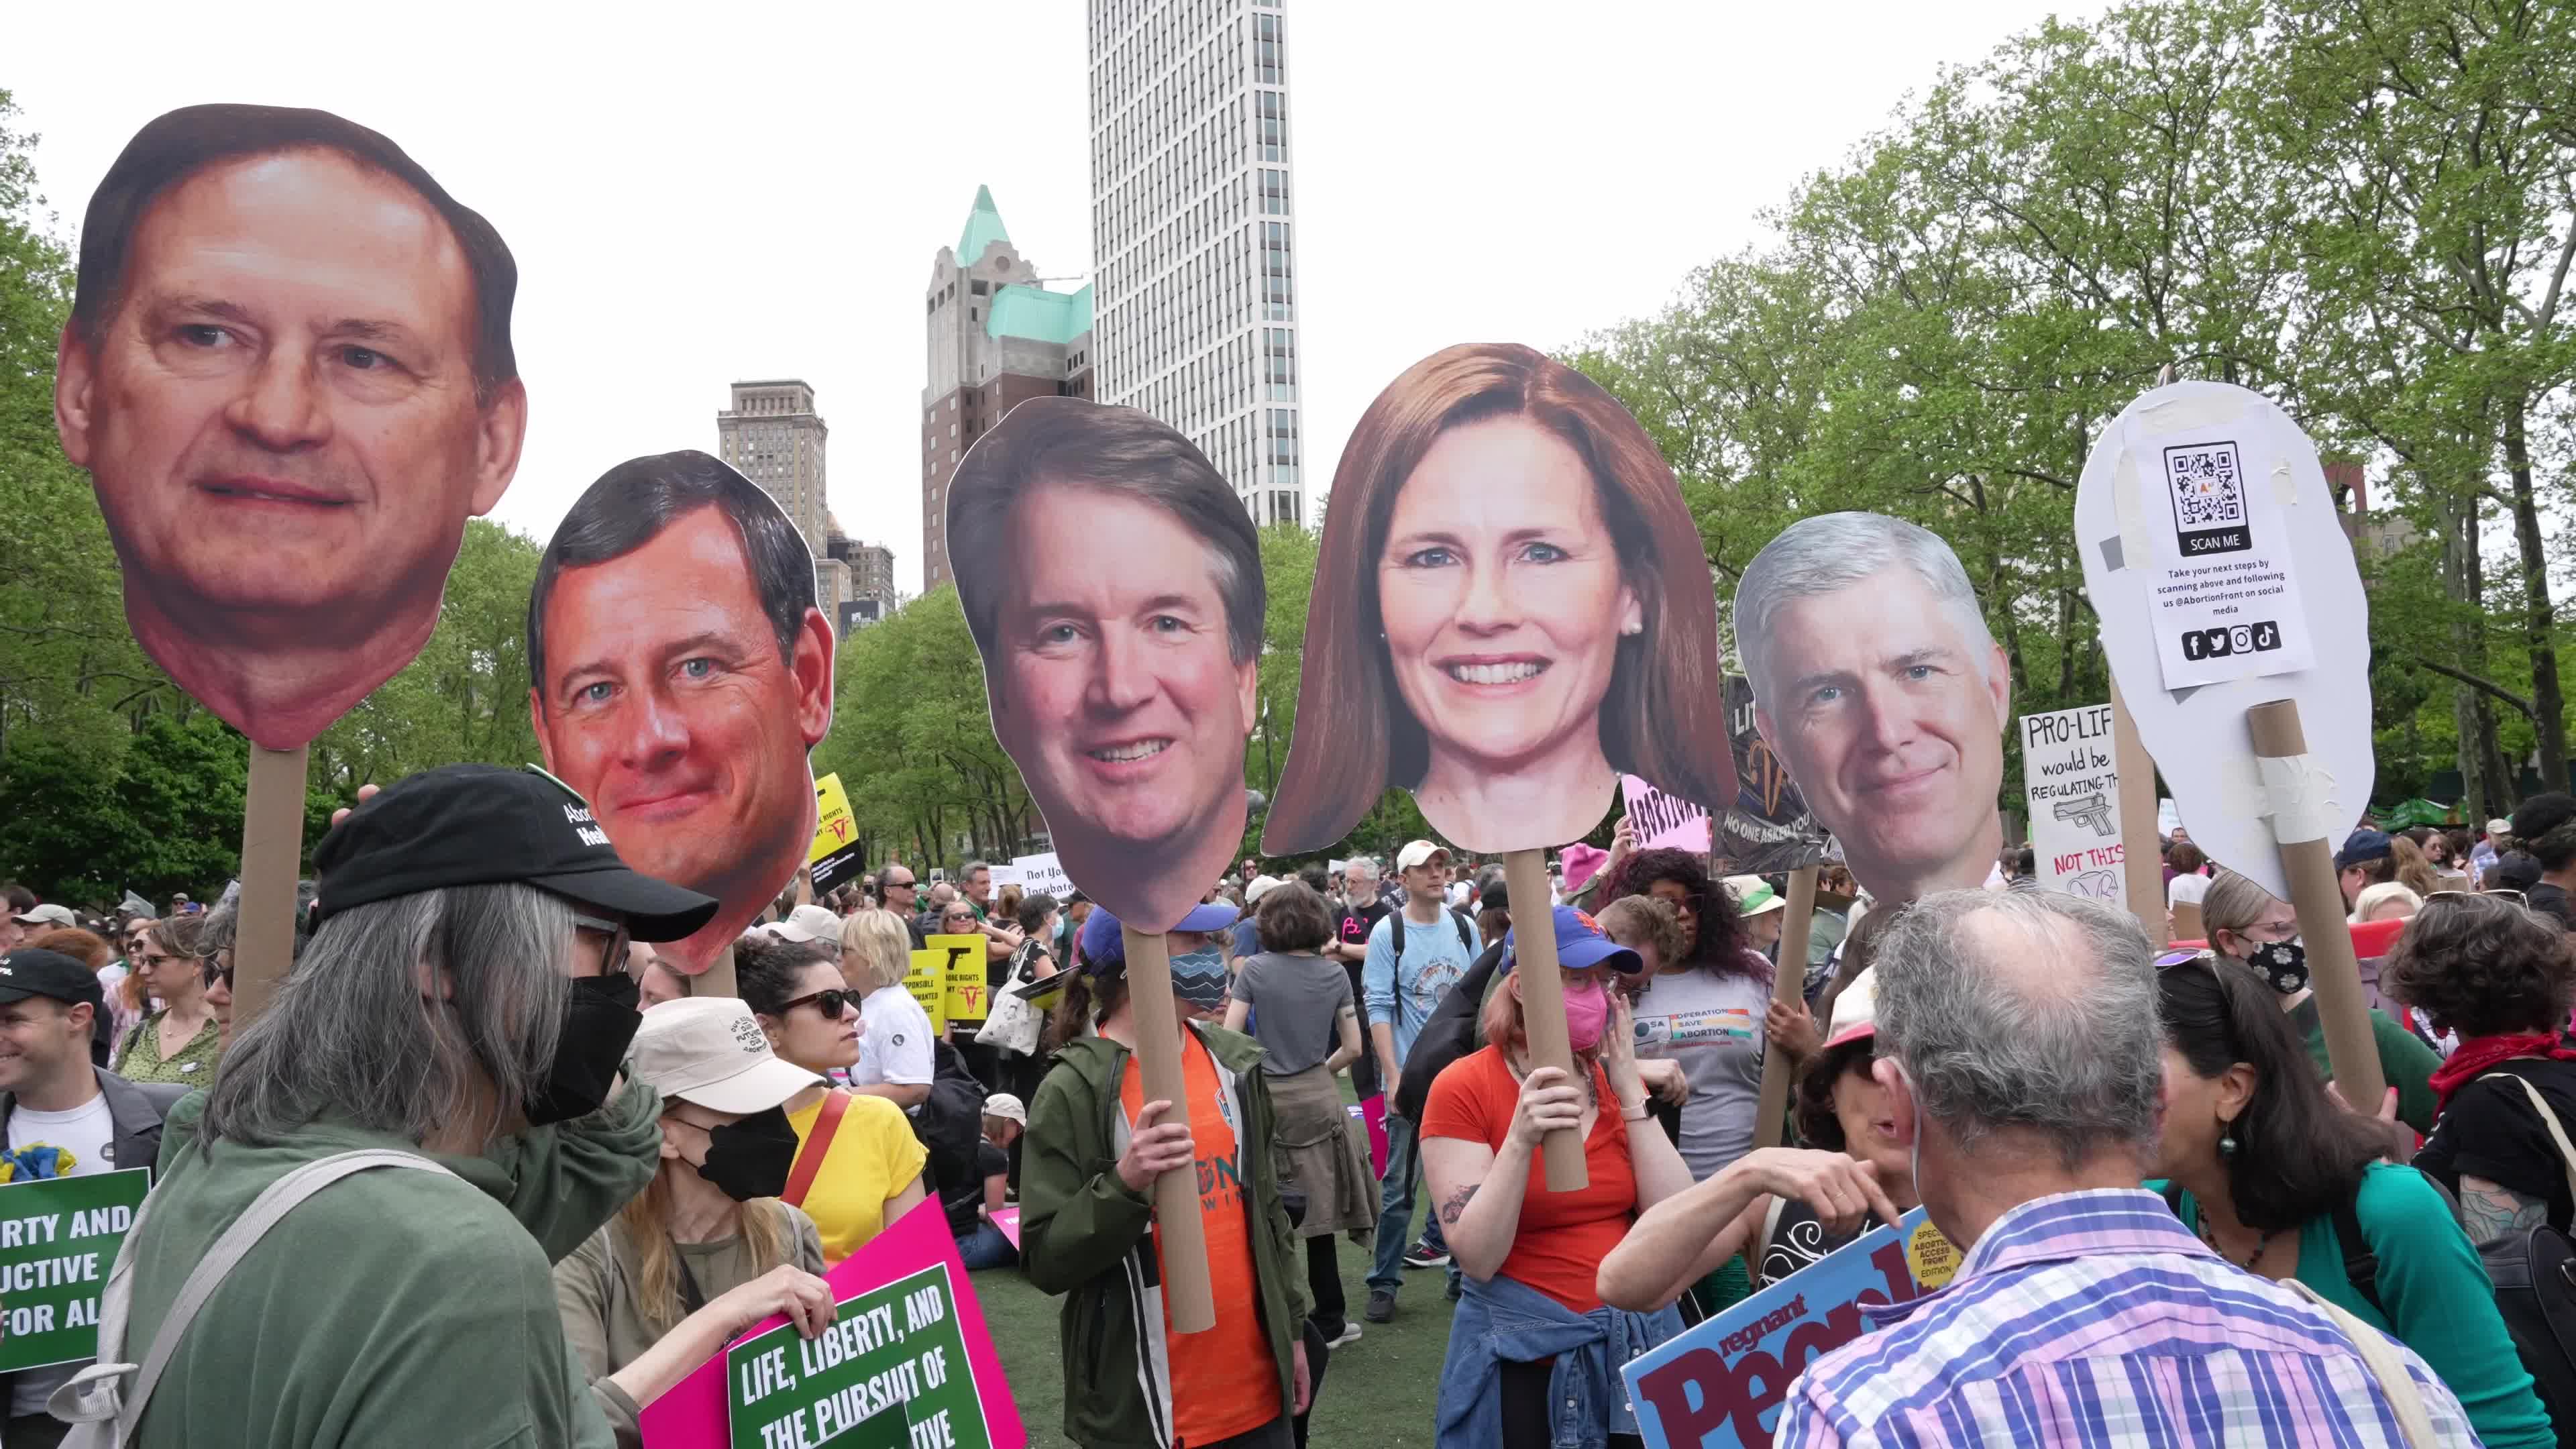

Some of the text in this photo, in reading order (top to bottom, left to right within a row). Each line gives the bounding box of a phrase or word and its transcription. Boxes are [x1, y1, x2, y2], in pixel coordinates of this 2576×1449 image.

[2190, 534, 2241, 551] SCAN ME
[2168, 559, 2269, 579] Take your next steps by
[2157, 572, 2285, 594] scanning above and following
[2176, 591, 2243, 607] @AbortionFront
[2258, 585, 2284, 596] social
[2212, 606, 2239, 616] media
[2042, 746, 2110, 776] would be
[2031, 776, 2104, 800] REGULATING
[823, 807, 843, 822] RIGHTS
[1724, 812, 1739, 834] NO
[1740, 826, 1760, 843] ONE
[1791, 812, 1810, 833] YOU
[2054, 844, 2126, 875] NOT THIS
[1026, 869, 1045, 880] Not
[959, 973, 979, 981] RIGHTS
[1677, 1008, 1728, 1019] OPERATION
[1678, 1020, 1702, 1028] SAVE
[1680, 1028, 1729, 1038] ABORTION
[0, 1205, 131, 1248] RTY AND
[1917, 1229, 1940, 1240] SPEC
[1920, 1247, 1950, 1258] ACCESS
[1923, 1255, 1949, 1267] FRONT
[1921, 1267, 1951, 1277] EDITION
[1718, 1292, 1809, 1360] regnant
[741, 1285, 945, 1406] LIFE, LIBERTY, AND
[760, 1344, 947, 1449] THE PURSUIT OF
